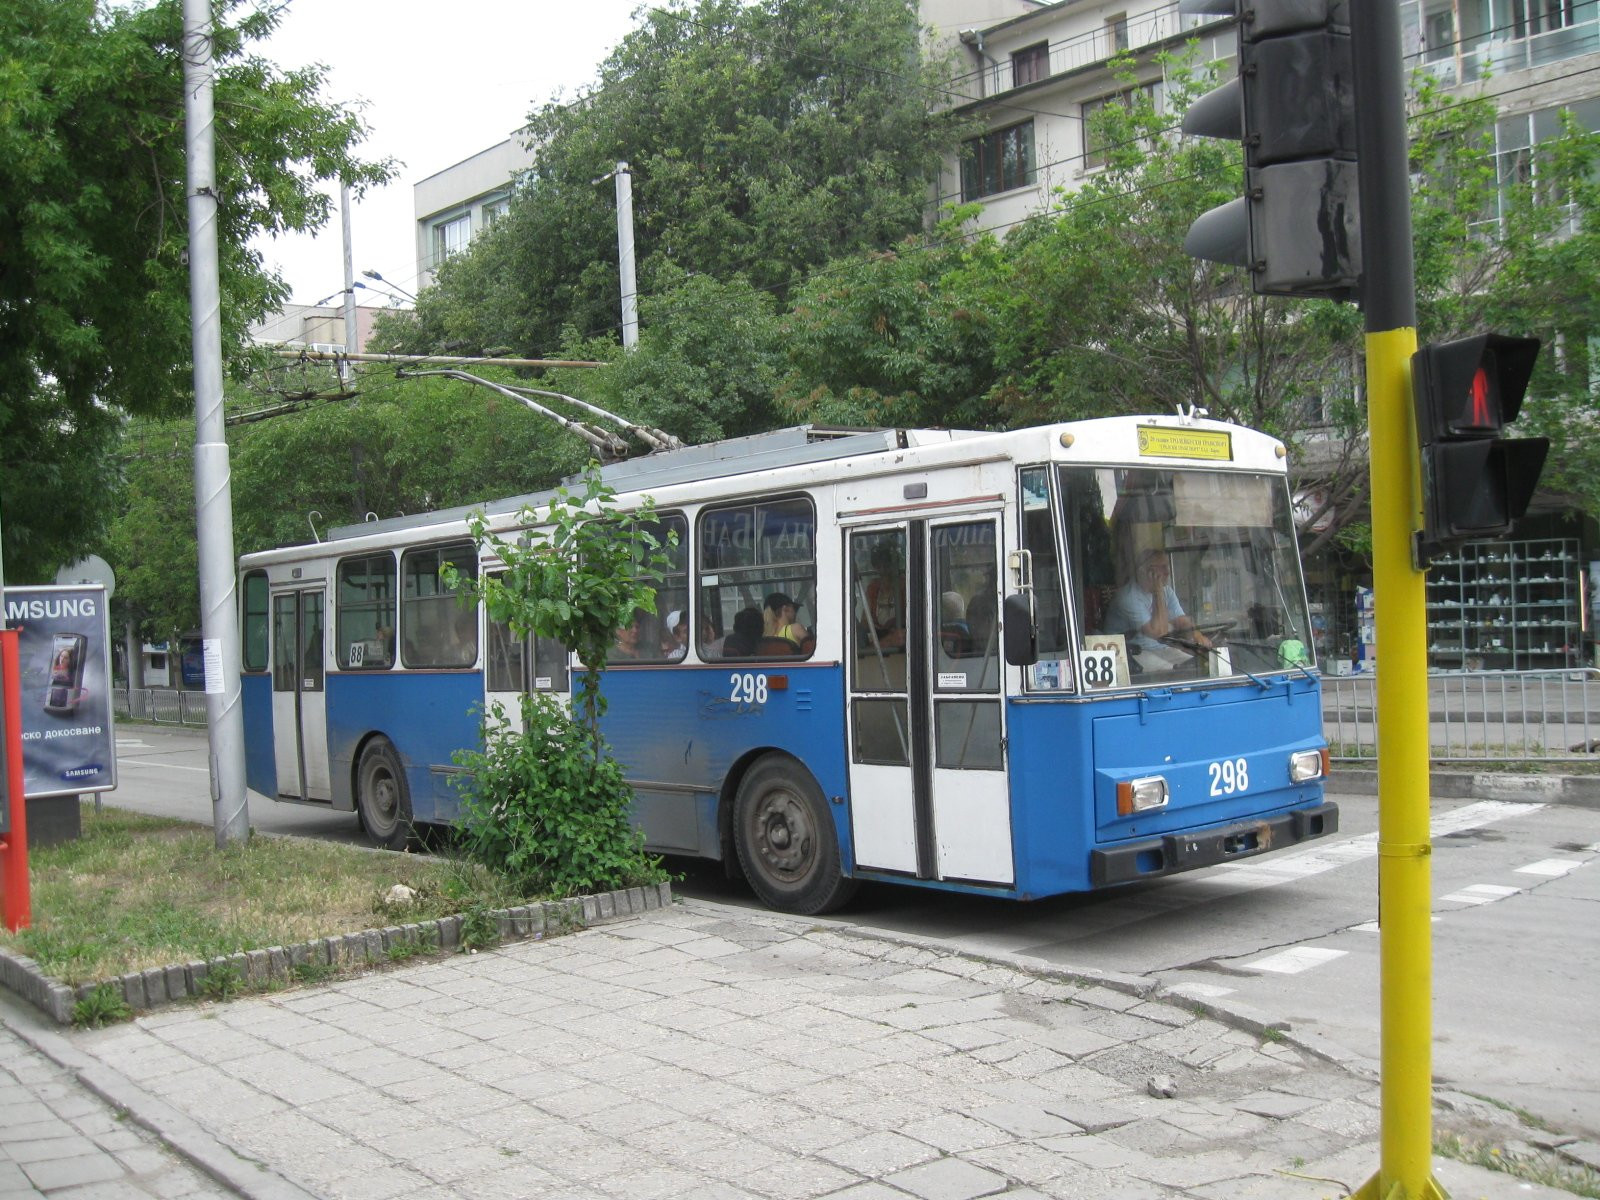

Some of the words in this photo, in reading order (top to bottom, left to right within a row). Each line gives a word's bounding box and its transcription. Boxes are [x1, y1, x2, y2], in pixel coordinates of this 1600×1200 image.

[5, 599, 95, 619] MSUNG
[351, 646, 362, 663] 88
[1085, 656, 1113, 685] 88
[731, 673, 767, 703] 298
[21, 732, 41, 740] ско
[45, 726, 102, 739] докосване
[65, 768, 98, 777] SAMSUNG
[1209, 758, 1248, 796] 298
